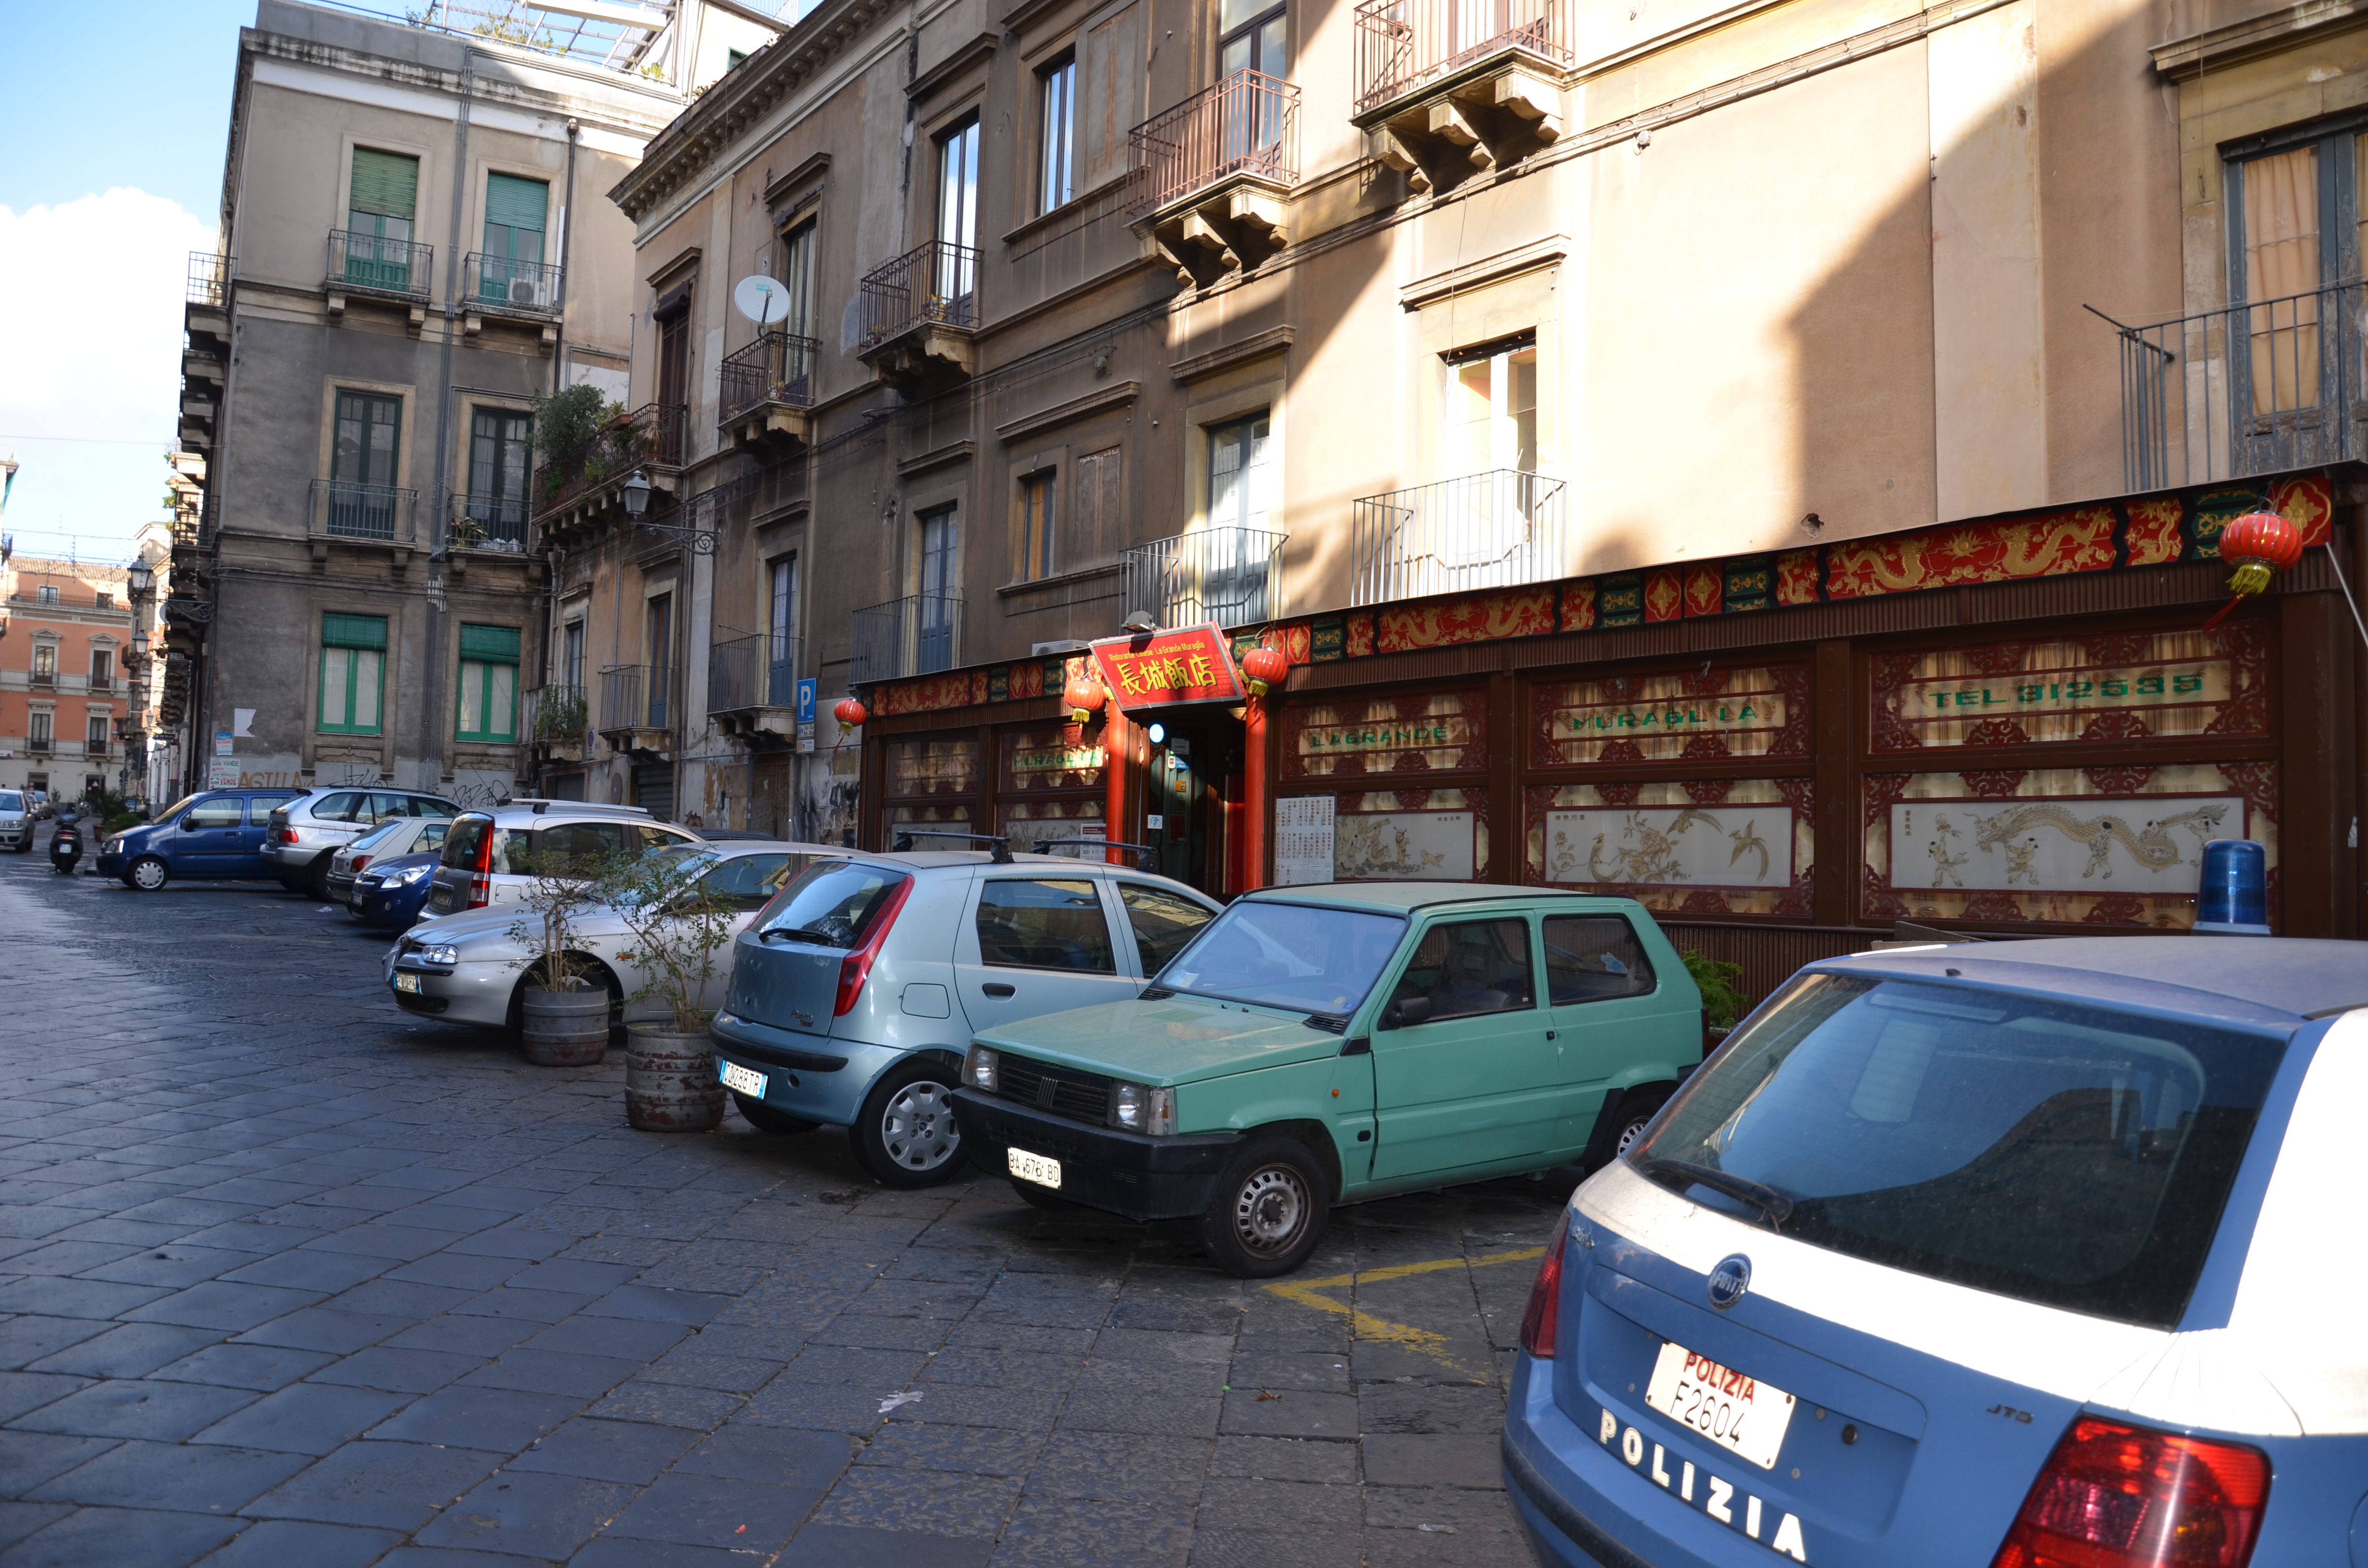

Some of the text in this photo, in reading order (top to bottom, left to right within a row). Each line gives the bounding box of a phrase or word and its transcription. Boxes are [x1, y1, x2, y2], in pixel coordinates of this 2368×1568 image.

[1108, 651, 1135, 662] Ristorante
[1135, 649, 1154, 658] Cinese
[1162, 644, 1183, 654] Grande
[1181, 640, 1205, 651] Muraglia
[1117, 653, 1217, 696] 長城飯店
[2018, 674, 2202, 702] 312535
[801, 686, 811, 716] P
[1573, 706, 1758, 730] MURAGLIA
[1014, 751, 1098, 767] MURAGLIA
[1010, 1153, 1059, 1182] BA 676 BD
[1712, 1271, 1741, 1293] FIAT
[1684, 1351, 1755, 1405] POLIZIA
[1670, 1380, 1745, 1447] F2604
[1986, 1404, 2034, 1423] JTD
[1600, 1409, 1806, 1561] POLIZIA
